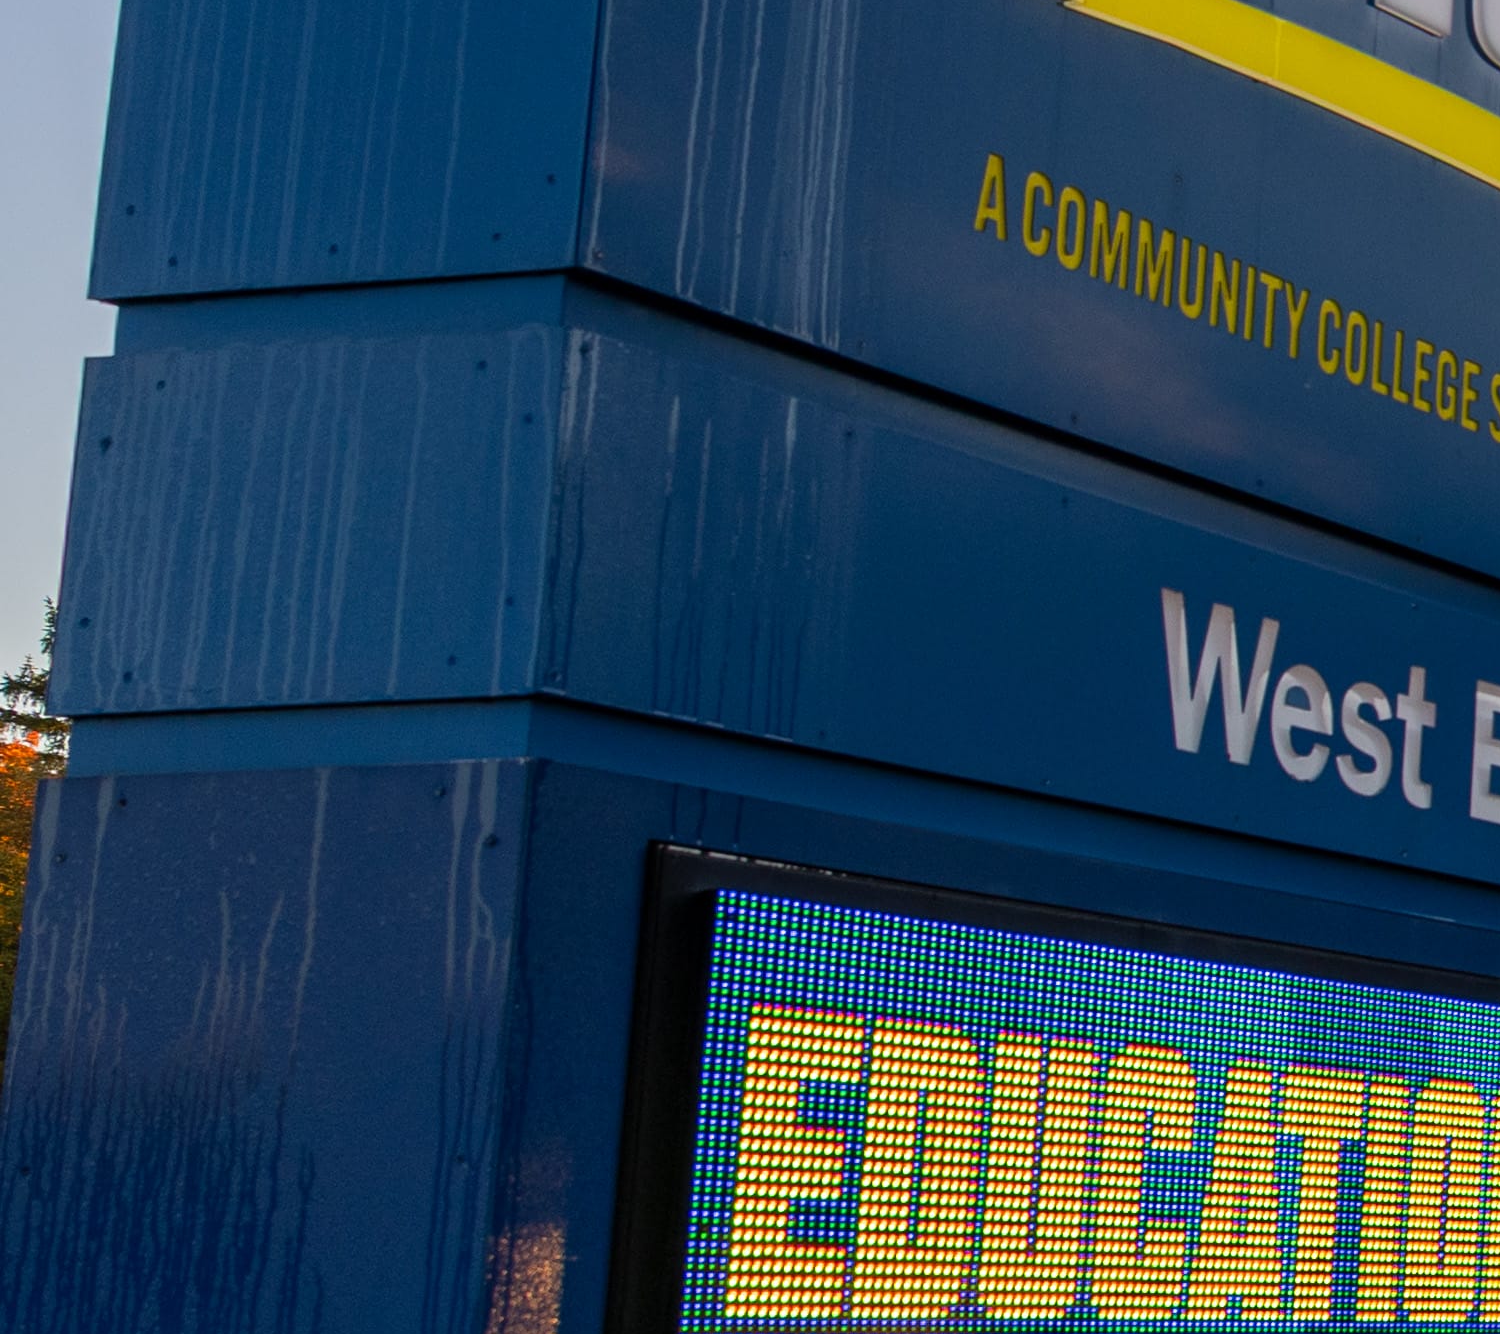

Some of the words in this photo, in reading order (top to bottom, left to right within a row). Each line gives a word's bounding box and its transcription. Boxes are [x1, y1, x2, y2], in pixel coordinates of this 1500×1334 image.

[972, 153, 1008, 240] A
[1021, 169, 1311, 359] COMMUNITY
[1315, 297, 1481, 433] COLLEGE
[1159, 586, 1437, 810] West
